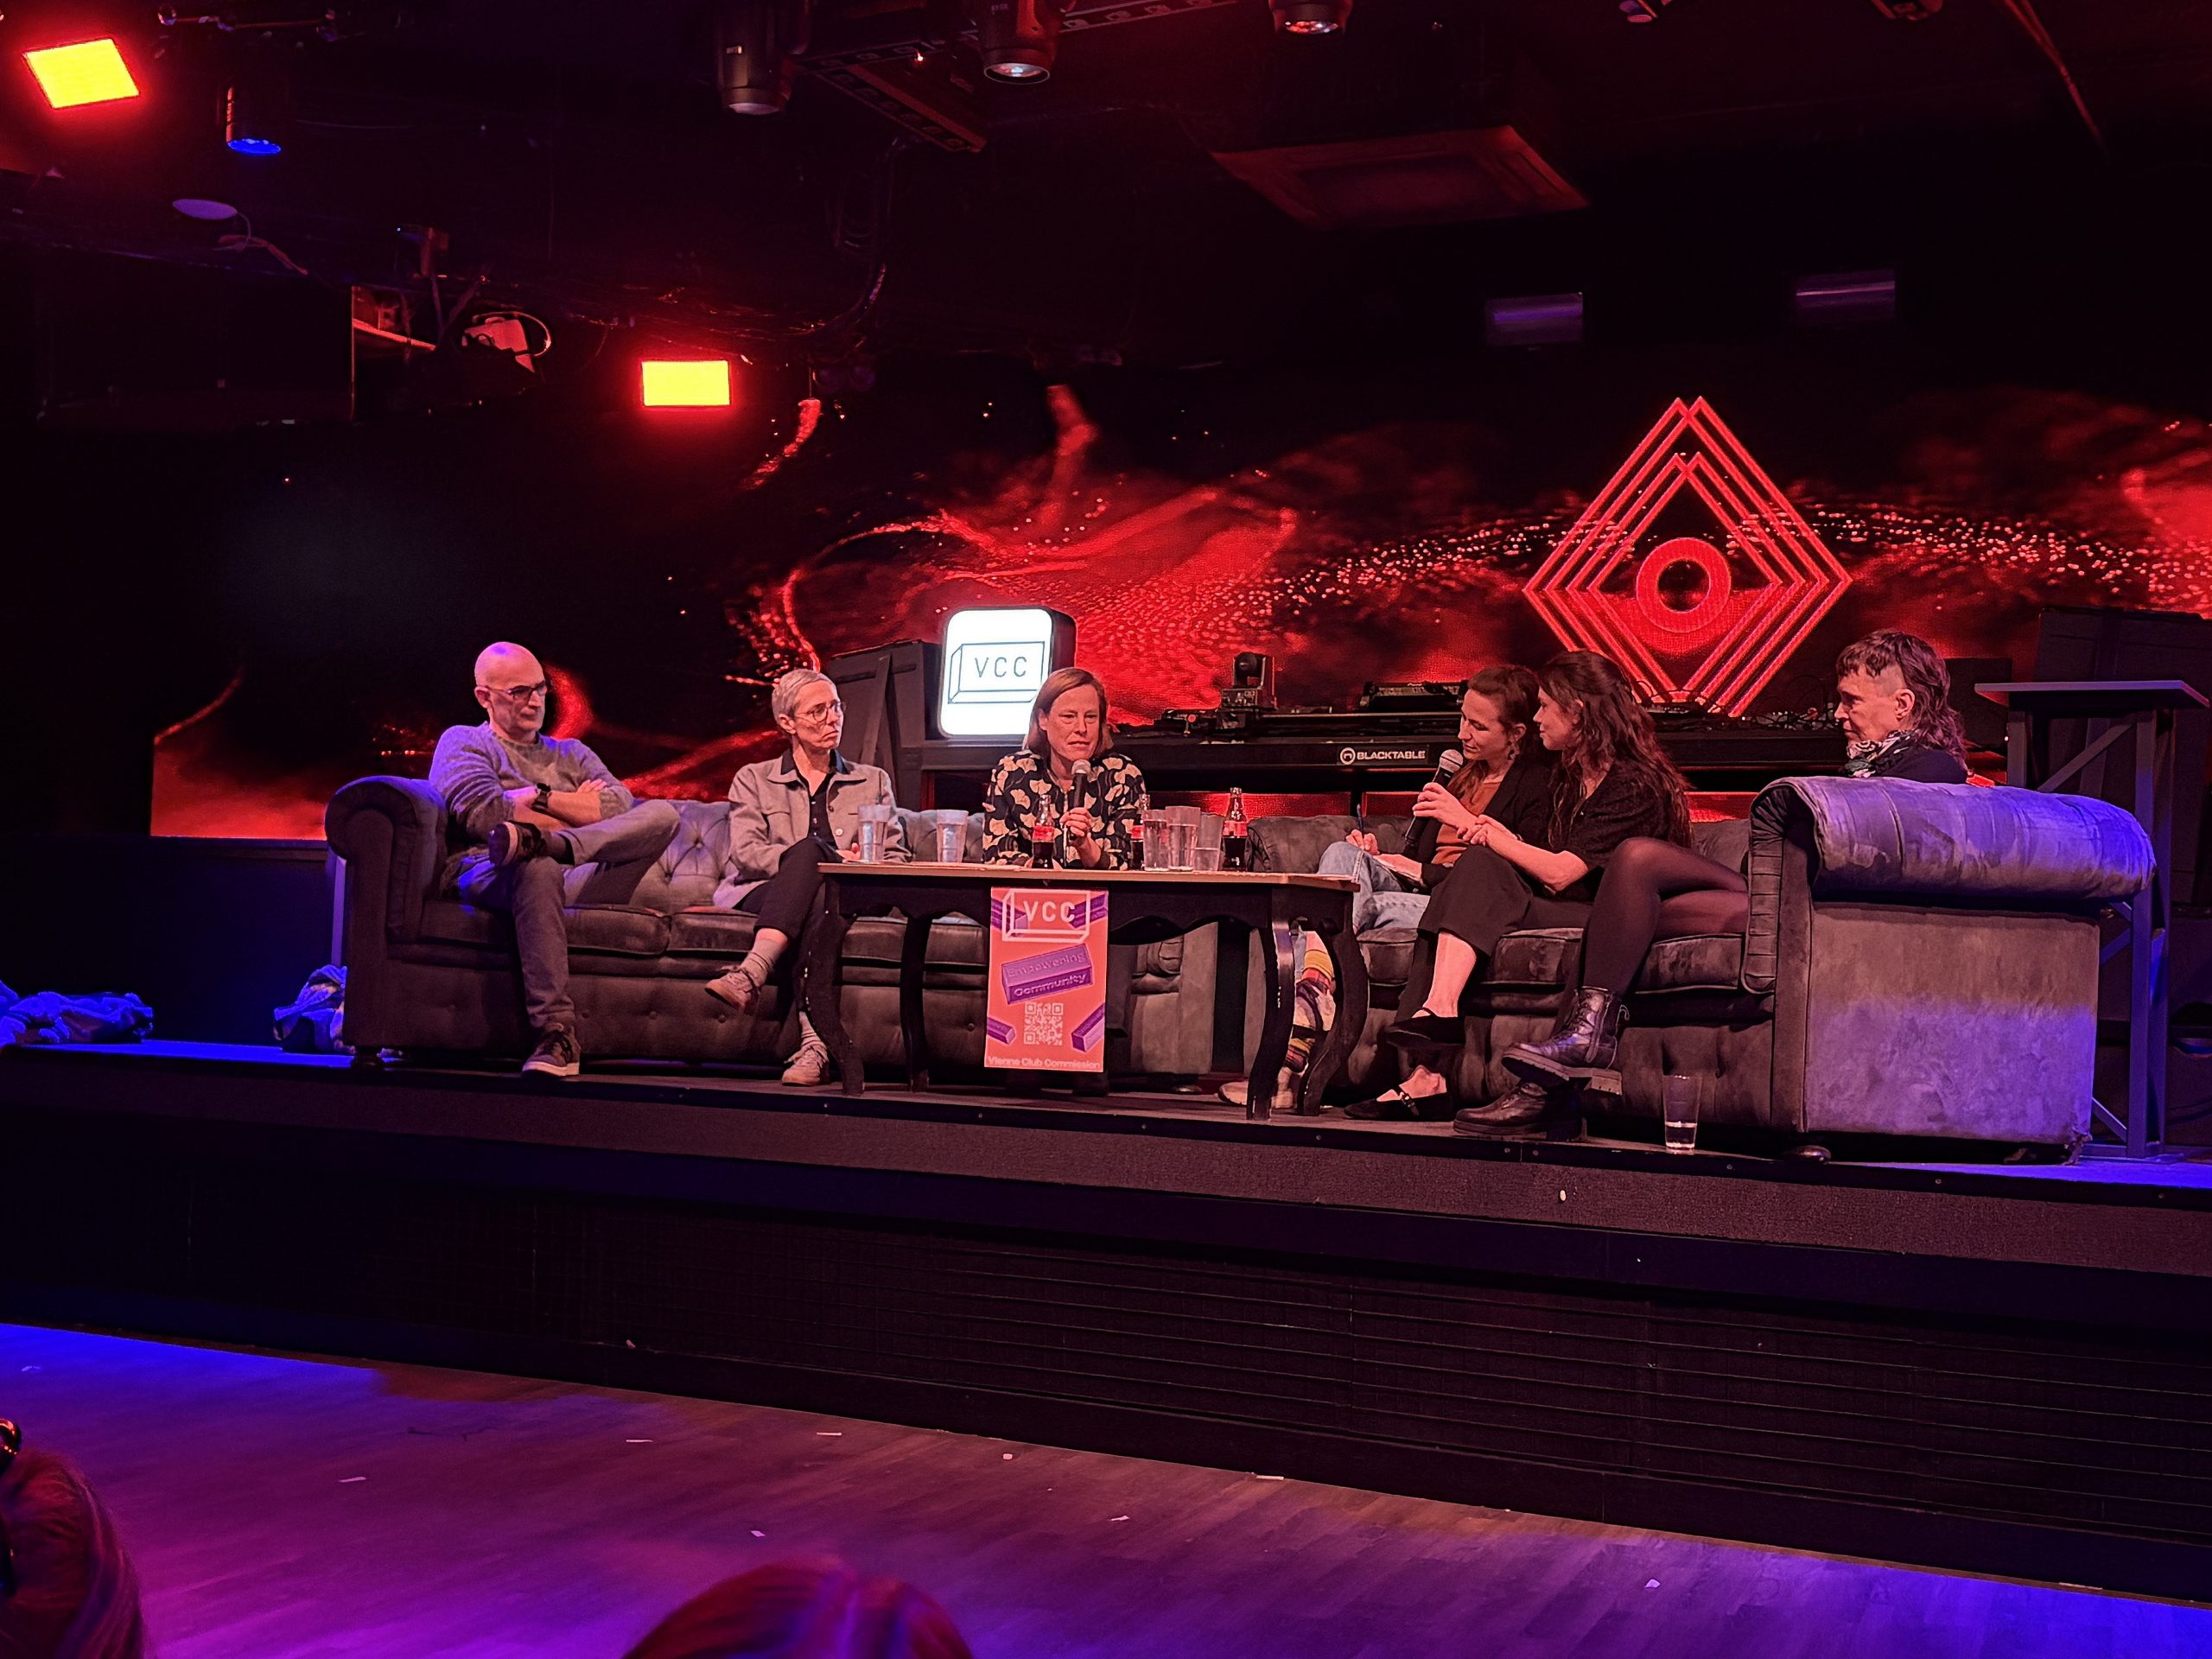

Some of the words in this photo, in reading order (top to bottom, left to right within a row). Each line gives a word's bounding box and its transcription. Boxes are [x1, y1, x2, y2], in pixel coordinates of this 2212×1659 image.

[975, 657, 1027, 677] VCC
[1357, 750, 1426, 760] BLACKTABLE
[1023, 900, 1076, 922] VCC
[1014, 973, 1086, 996] Community
[988, 1056, 1020, 1066] Vienna
[1021, 1058, 1043, 1066] Club
[1044, 1058, 1100, 1069] Commission
